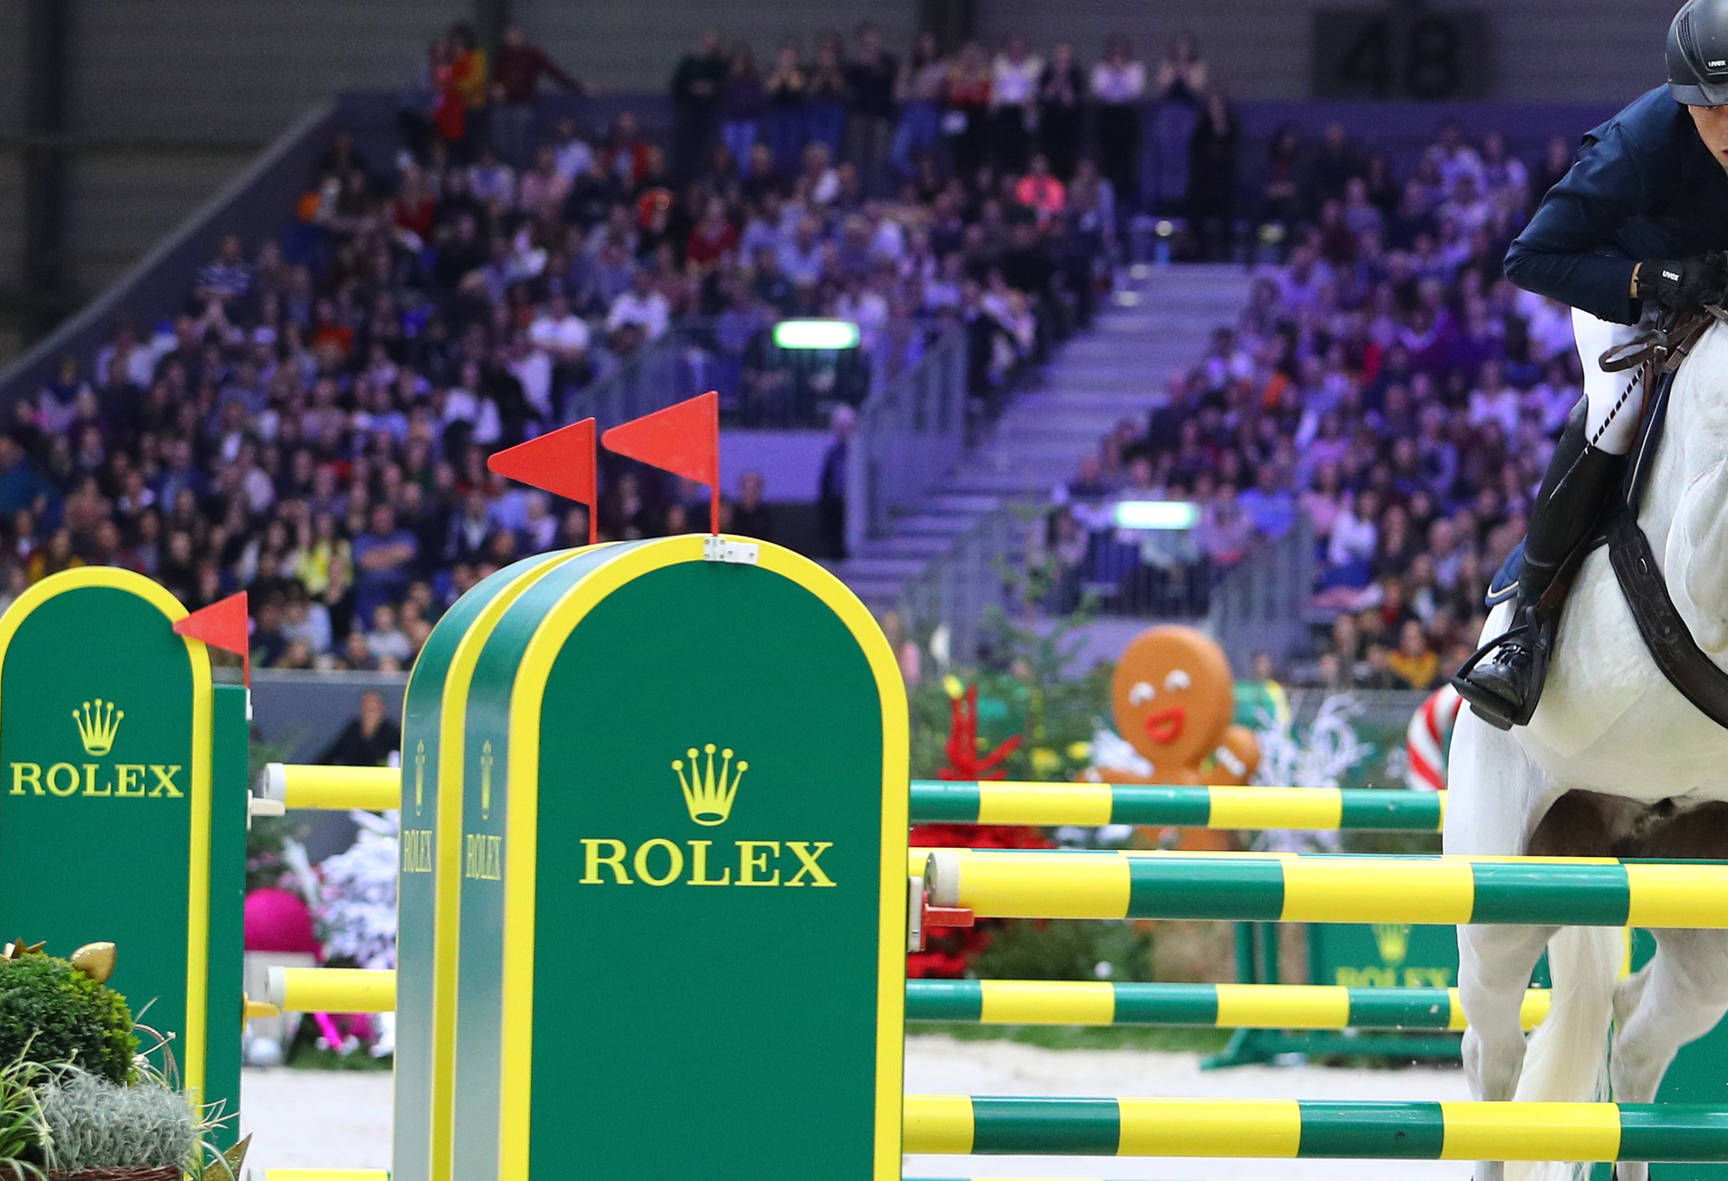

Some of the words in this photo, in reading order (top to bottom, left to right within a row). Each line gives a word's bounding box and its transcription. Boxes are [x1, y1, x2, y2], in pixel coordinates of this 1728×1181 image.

[1336, 15, 1459, 97] 48
[1662, 270, 1680, 281] uvex
[9, 762, 183, 798] ROLEX
[403, 829, 432, 873] ROLEX
[465, 833, 502, 881] ROLEX
[579, 838, 837, 887] ROLEX
